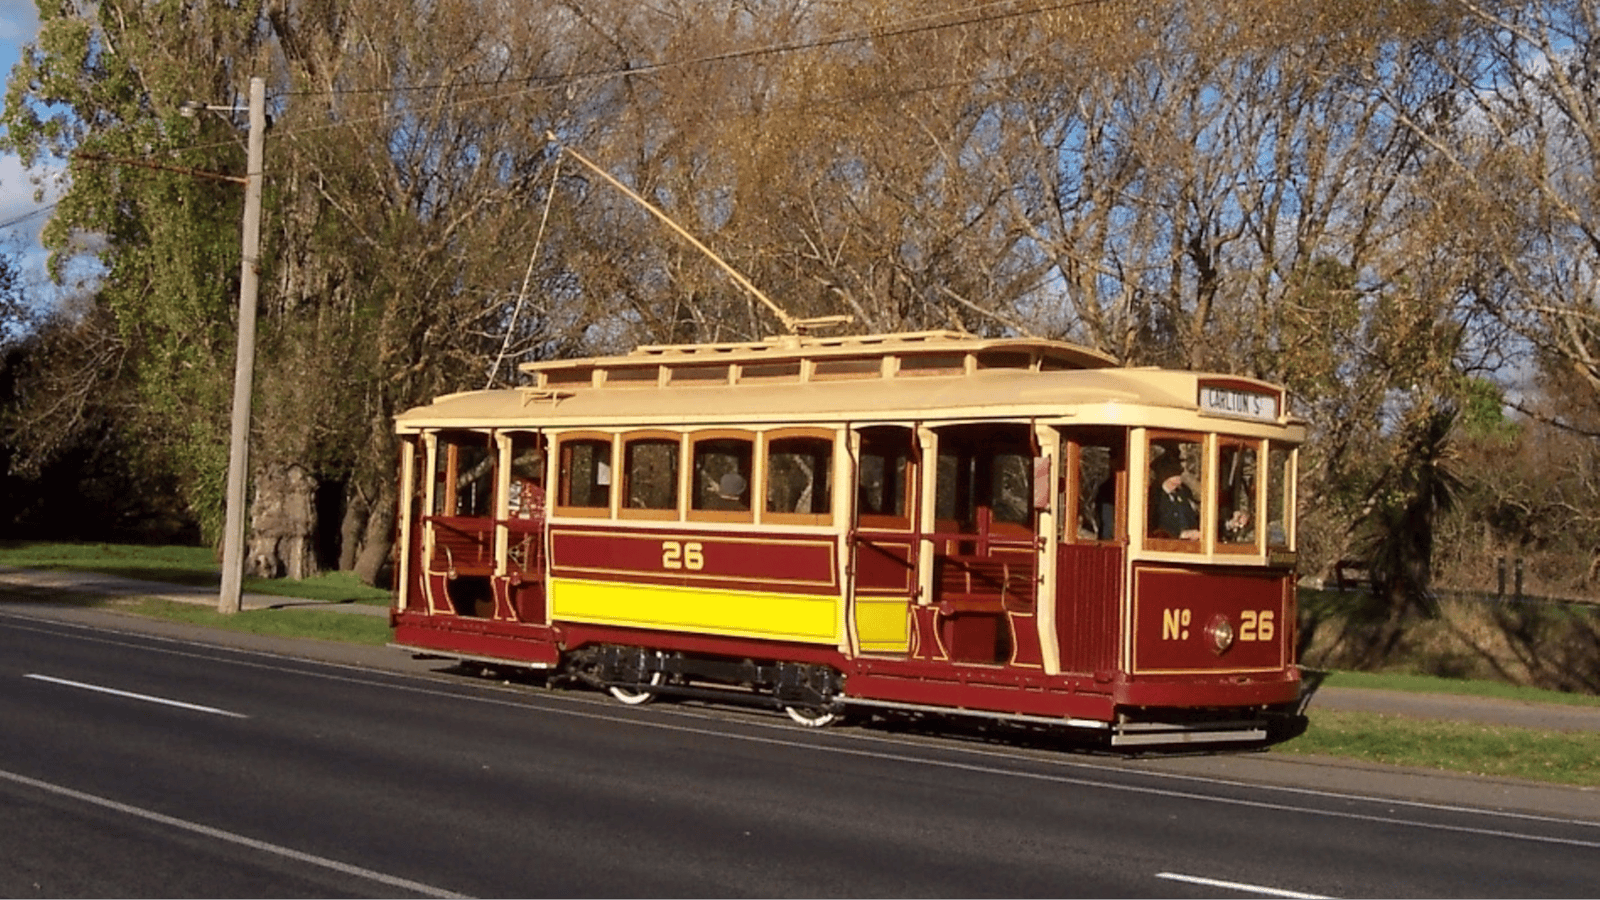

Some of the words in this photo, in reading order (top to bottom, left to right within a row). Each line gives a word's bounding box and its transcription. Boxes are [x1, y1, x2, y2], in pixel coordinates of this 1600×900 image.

[1208, 388, 1249, 413] CARLTON
[662, 541, 704, 570] 26
[1240, 610, 1274, 641] 26
